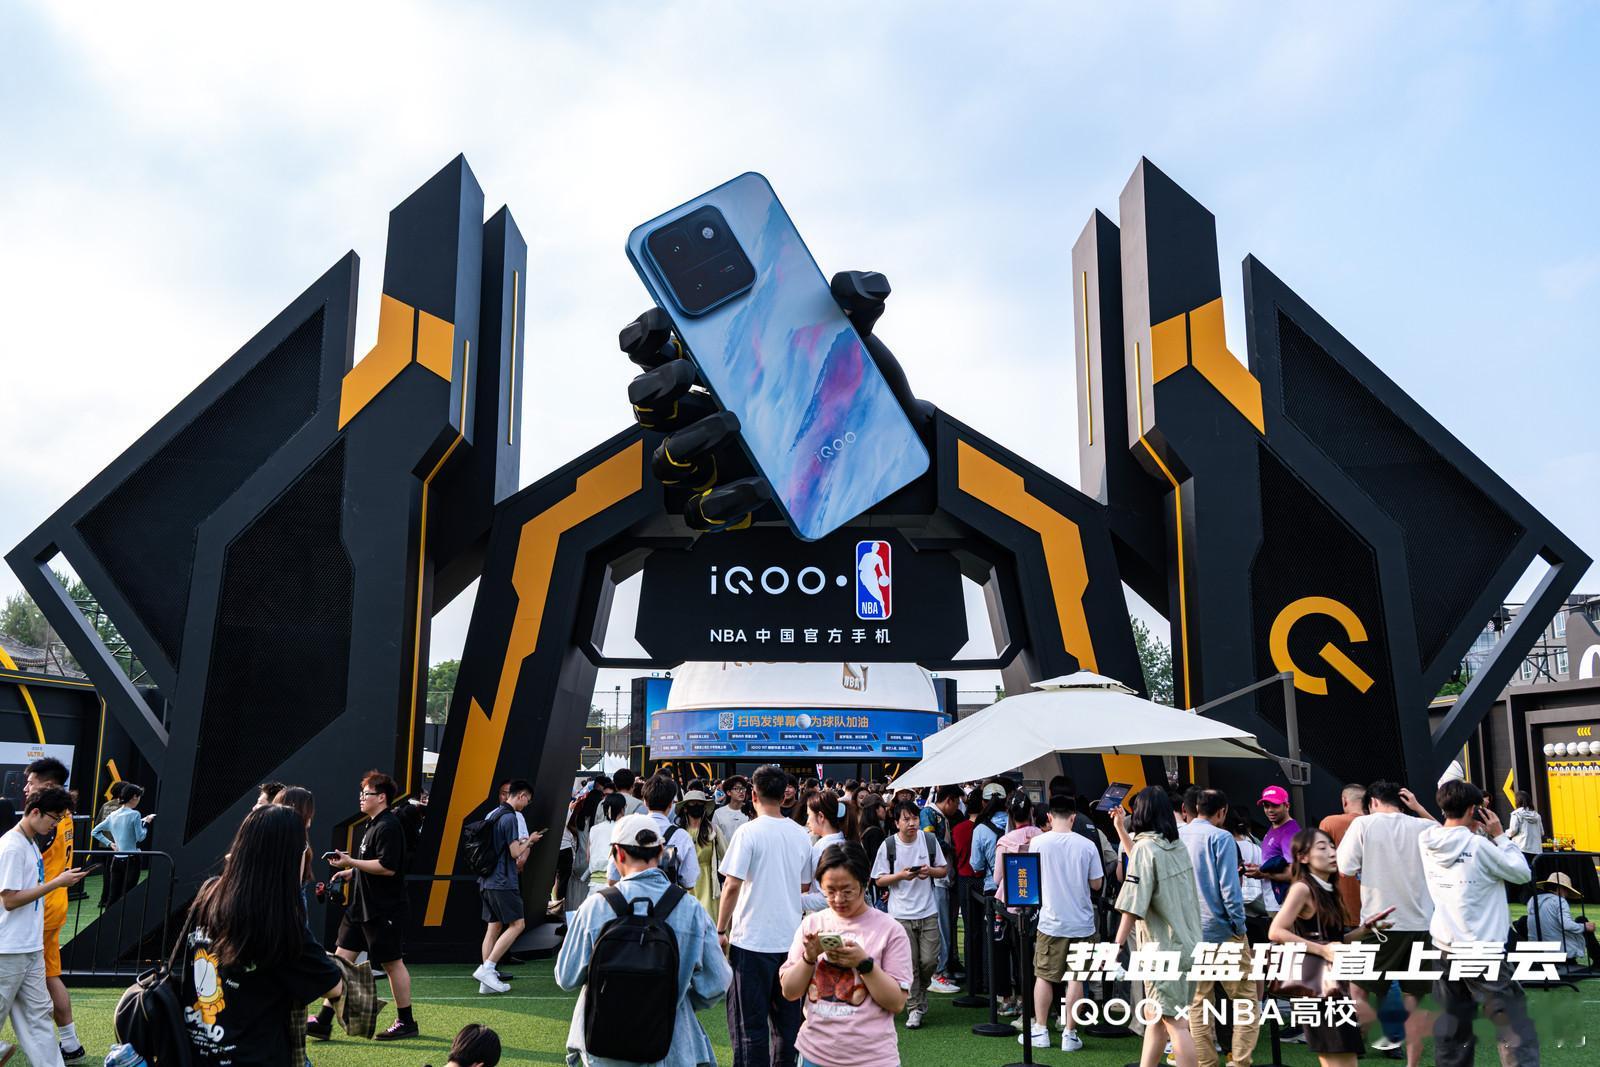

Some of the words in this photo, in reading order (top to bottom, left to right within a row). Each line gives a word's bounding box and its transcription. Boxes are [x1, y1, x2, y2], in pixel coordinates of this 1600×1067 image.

[814, 431, 857, 463] iQOO
[710, 565, 826, 595] iQOO
[861, 601, 879, 615] NBA
